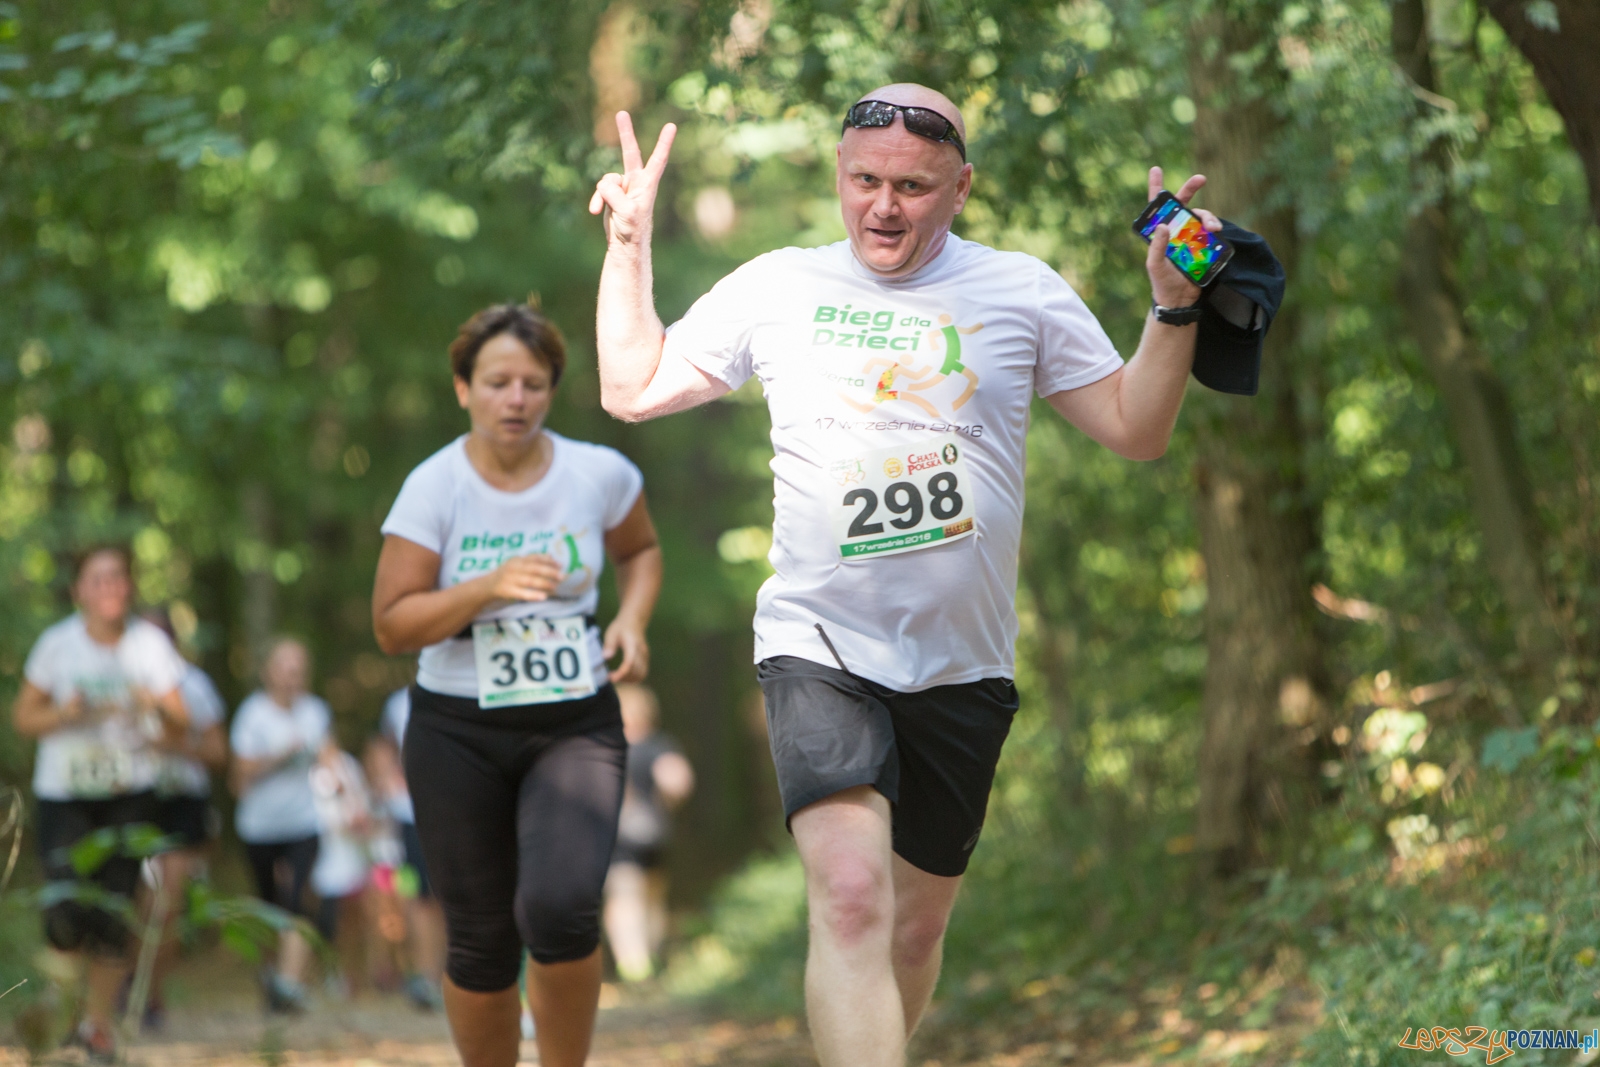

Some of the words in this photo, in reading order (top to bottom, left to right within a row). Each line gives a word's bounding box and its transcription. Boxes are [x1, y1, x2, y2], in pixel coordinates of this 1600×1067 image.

[813, 304, 895, 332] Bieg
[900, 316, 931, 327] dla
[812, 329, 922, 351] Dzieci
[815, 417, 835, 430] 17
[838, 419, 926, 432] września
[929, 422, 984, 438] 2016
[907, 451, 940, 465] CHATA
[907, 459, 943, 475] POLSKA
[842, 471, 964, 538] 298
[460, 531, 525, 551] Bieg
[853, 545, 867, 553] 17
[904, 532, 932, 545] 2016
[490, 646, 581, 687] 360
